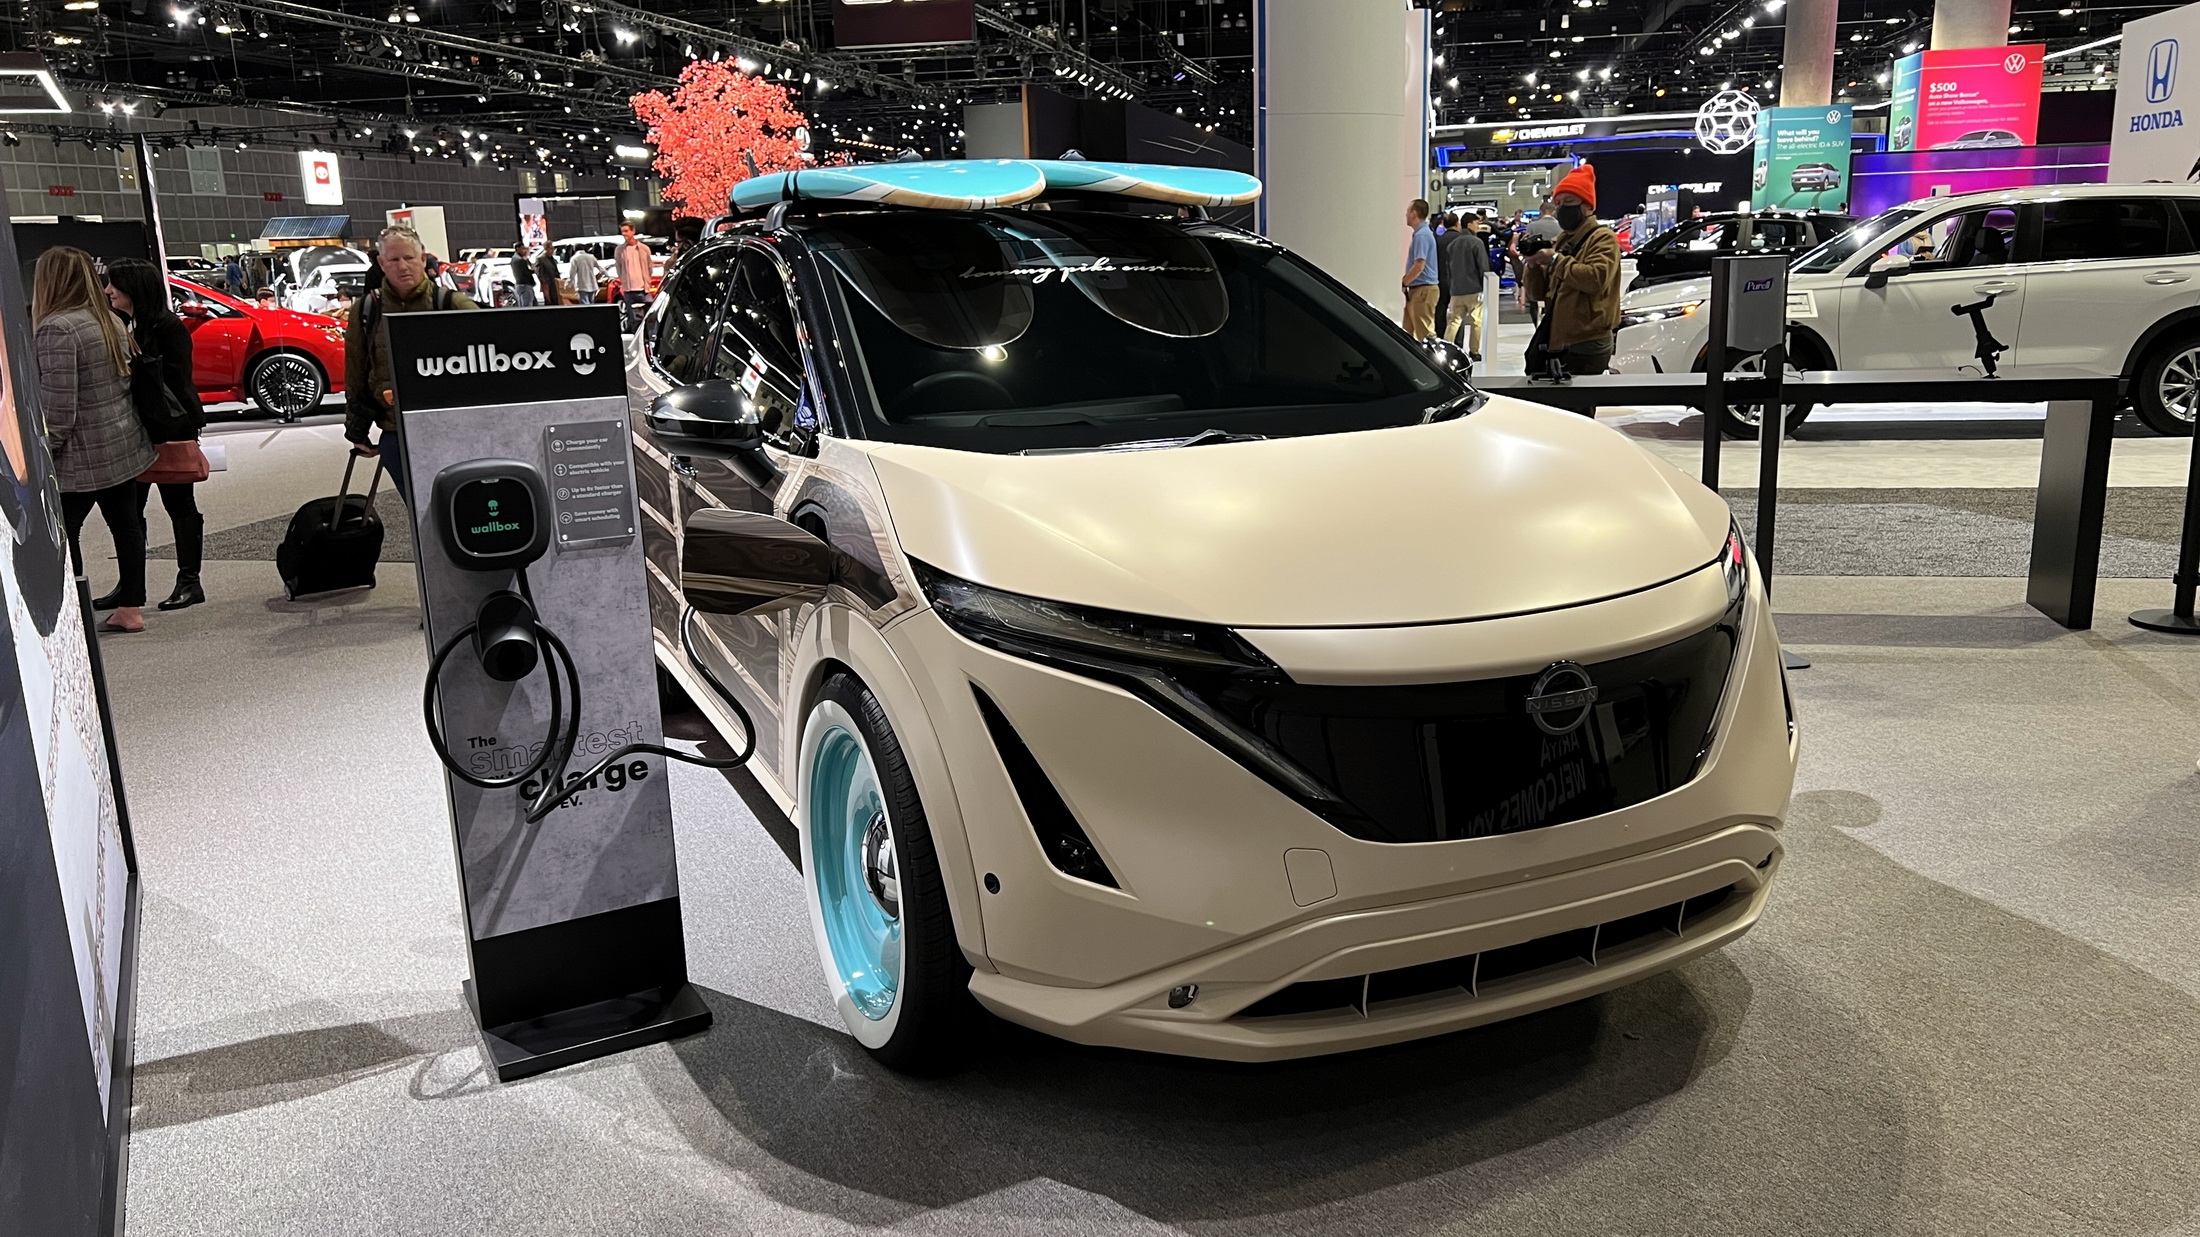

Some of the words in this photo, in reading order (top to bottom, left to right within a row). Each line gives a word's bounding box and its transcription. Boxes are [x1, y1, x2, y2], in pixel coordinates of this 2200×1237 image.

[1929, 82, 1957, 93] $500
[2129, 109, 2184, 133] HONDA
[1518, 123, 1587, 141] CHEVROLET
[1776, 129, 1795, 137] What
[1807, 129, 1820, 137] you
[1831, 140, 1845, 148] SUV
[958, 265, 1056, 284] tommy
[1058, 256, 1117, 284] pike
[1122, 260, 1215, 274] customs
[1746, 280, 1771, 291] Purell
[416, 343, 557, 377] wallbox
[470, 521, 520, 534] wallbox
[1527, 689, 1597, 711] NISSAN
[467, 735, 497, 749] The
